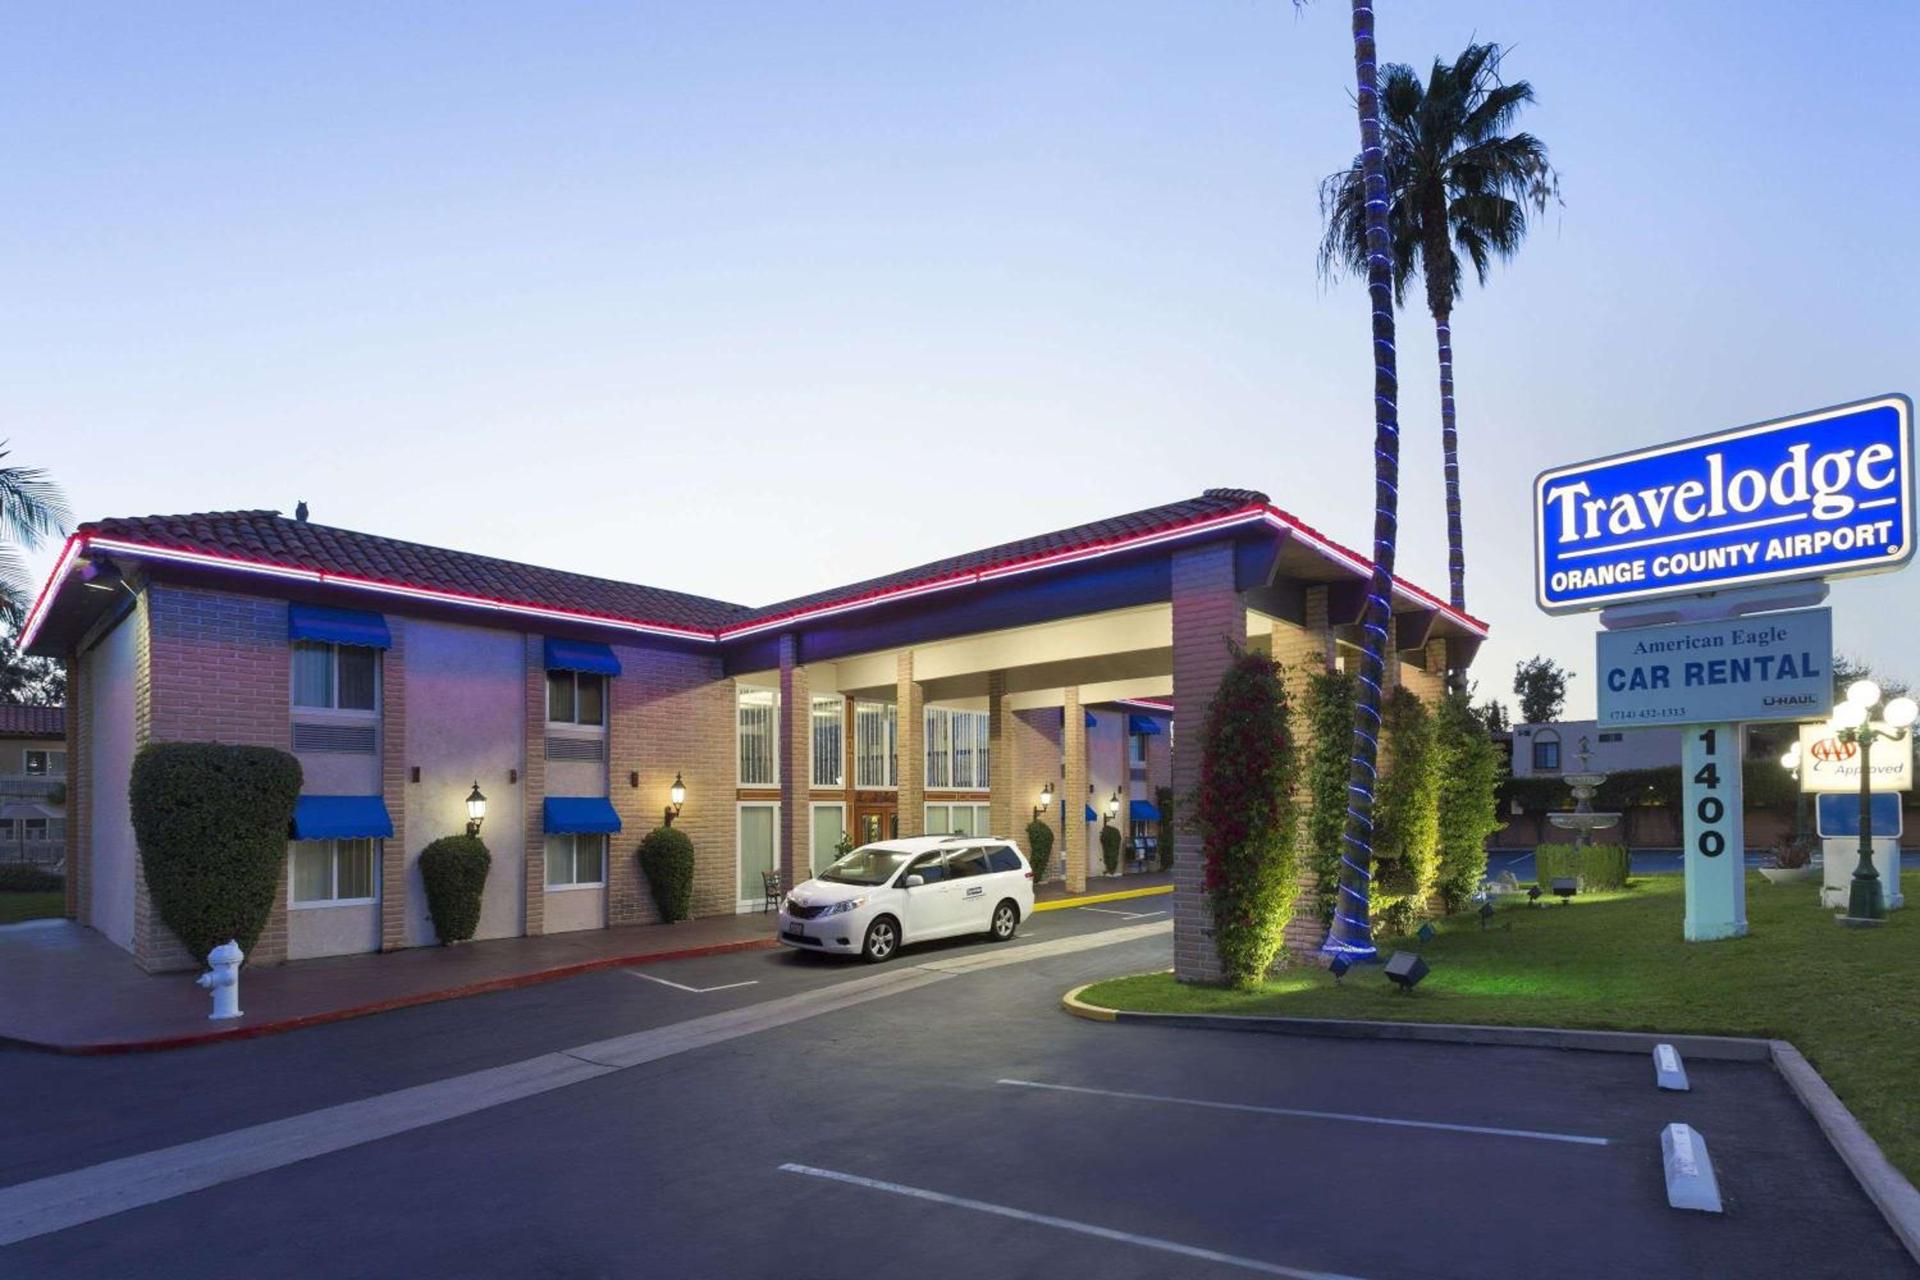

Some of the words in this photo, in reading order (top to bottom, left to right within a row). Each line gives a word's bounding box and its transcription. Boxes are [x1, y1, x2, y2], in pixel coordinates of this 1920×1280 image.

[1547, 442, 1896, 543] Travelodge
[1551, 560, 1646, 592] ORANGE
[1653, 543, 1760, 577] COUNTY
[1765, 520, 1893, 561] AIRPORT
[1633, 633, 1724, 655] American
[1731, 626, 1788, 647] Eagle
[1607, 664, 1670, 692] CAR
[1685, 652, 1820, 687] RENTAL
[1834, 763, 1904, 777] Appoved
